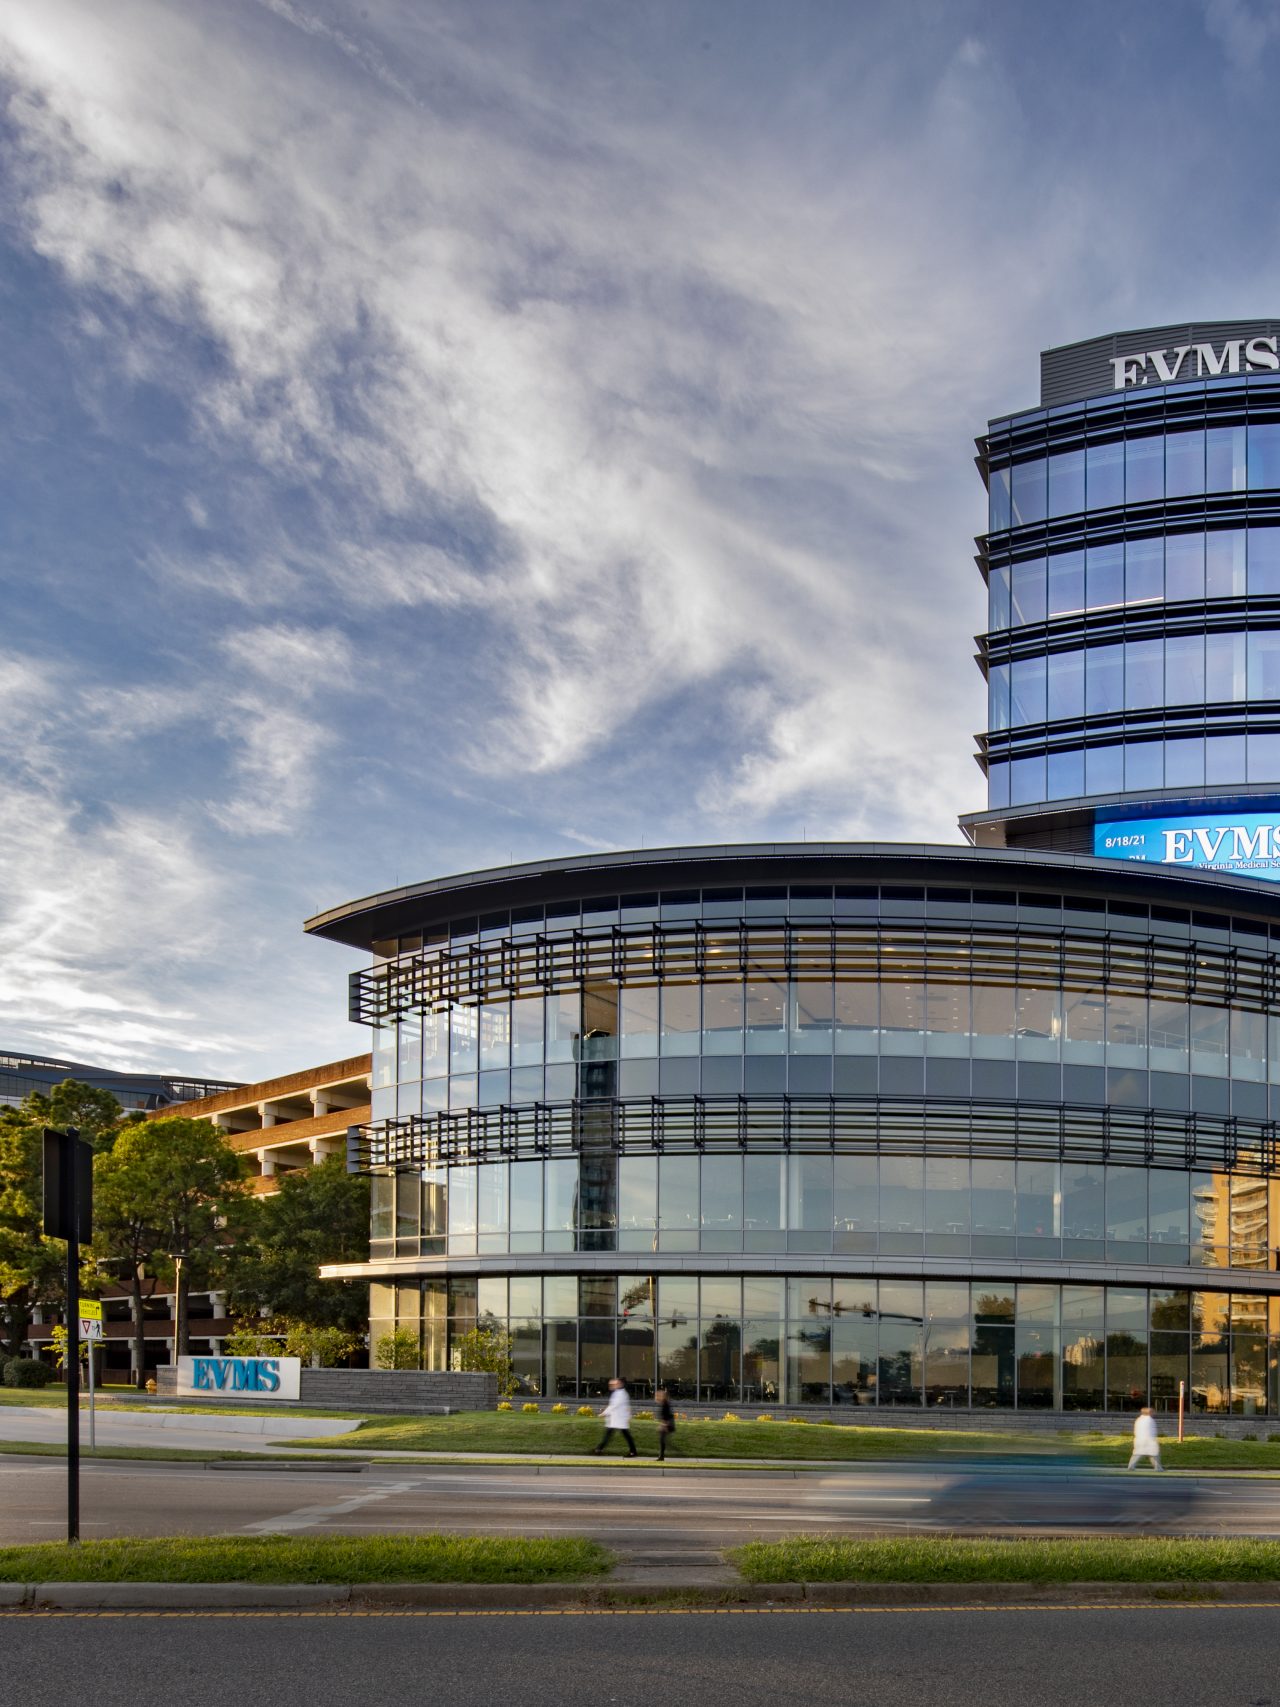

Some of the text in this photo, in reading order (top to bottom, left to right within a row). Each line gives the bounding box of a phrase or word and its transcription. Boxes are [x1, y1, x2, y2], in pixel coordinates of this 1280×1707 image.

[1109, 336, 1280, 390] EVMS
[1105, 835, 1145, 848] 8/18/21
[1198, 861, 1233, 870] Virginia
[1235, 861, 1268, 869] Medical
[191, 1358, 280, 1392] EVMS
